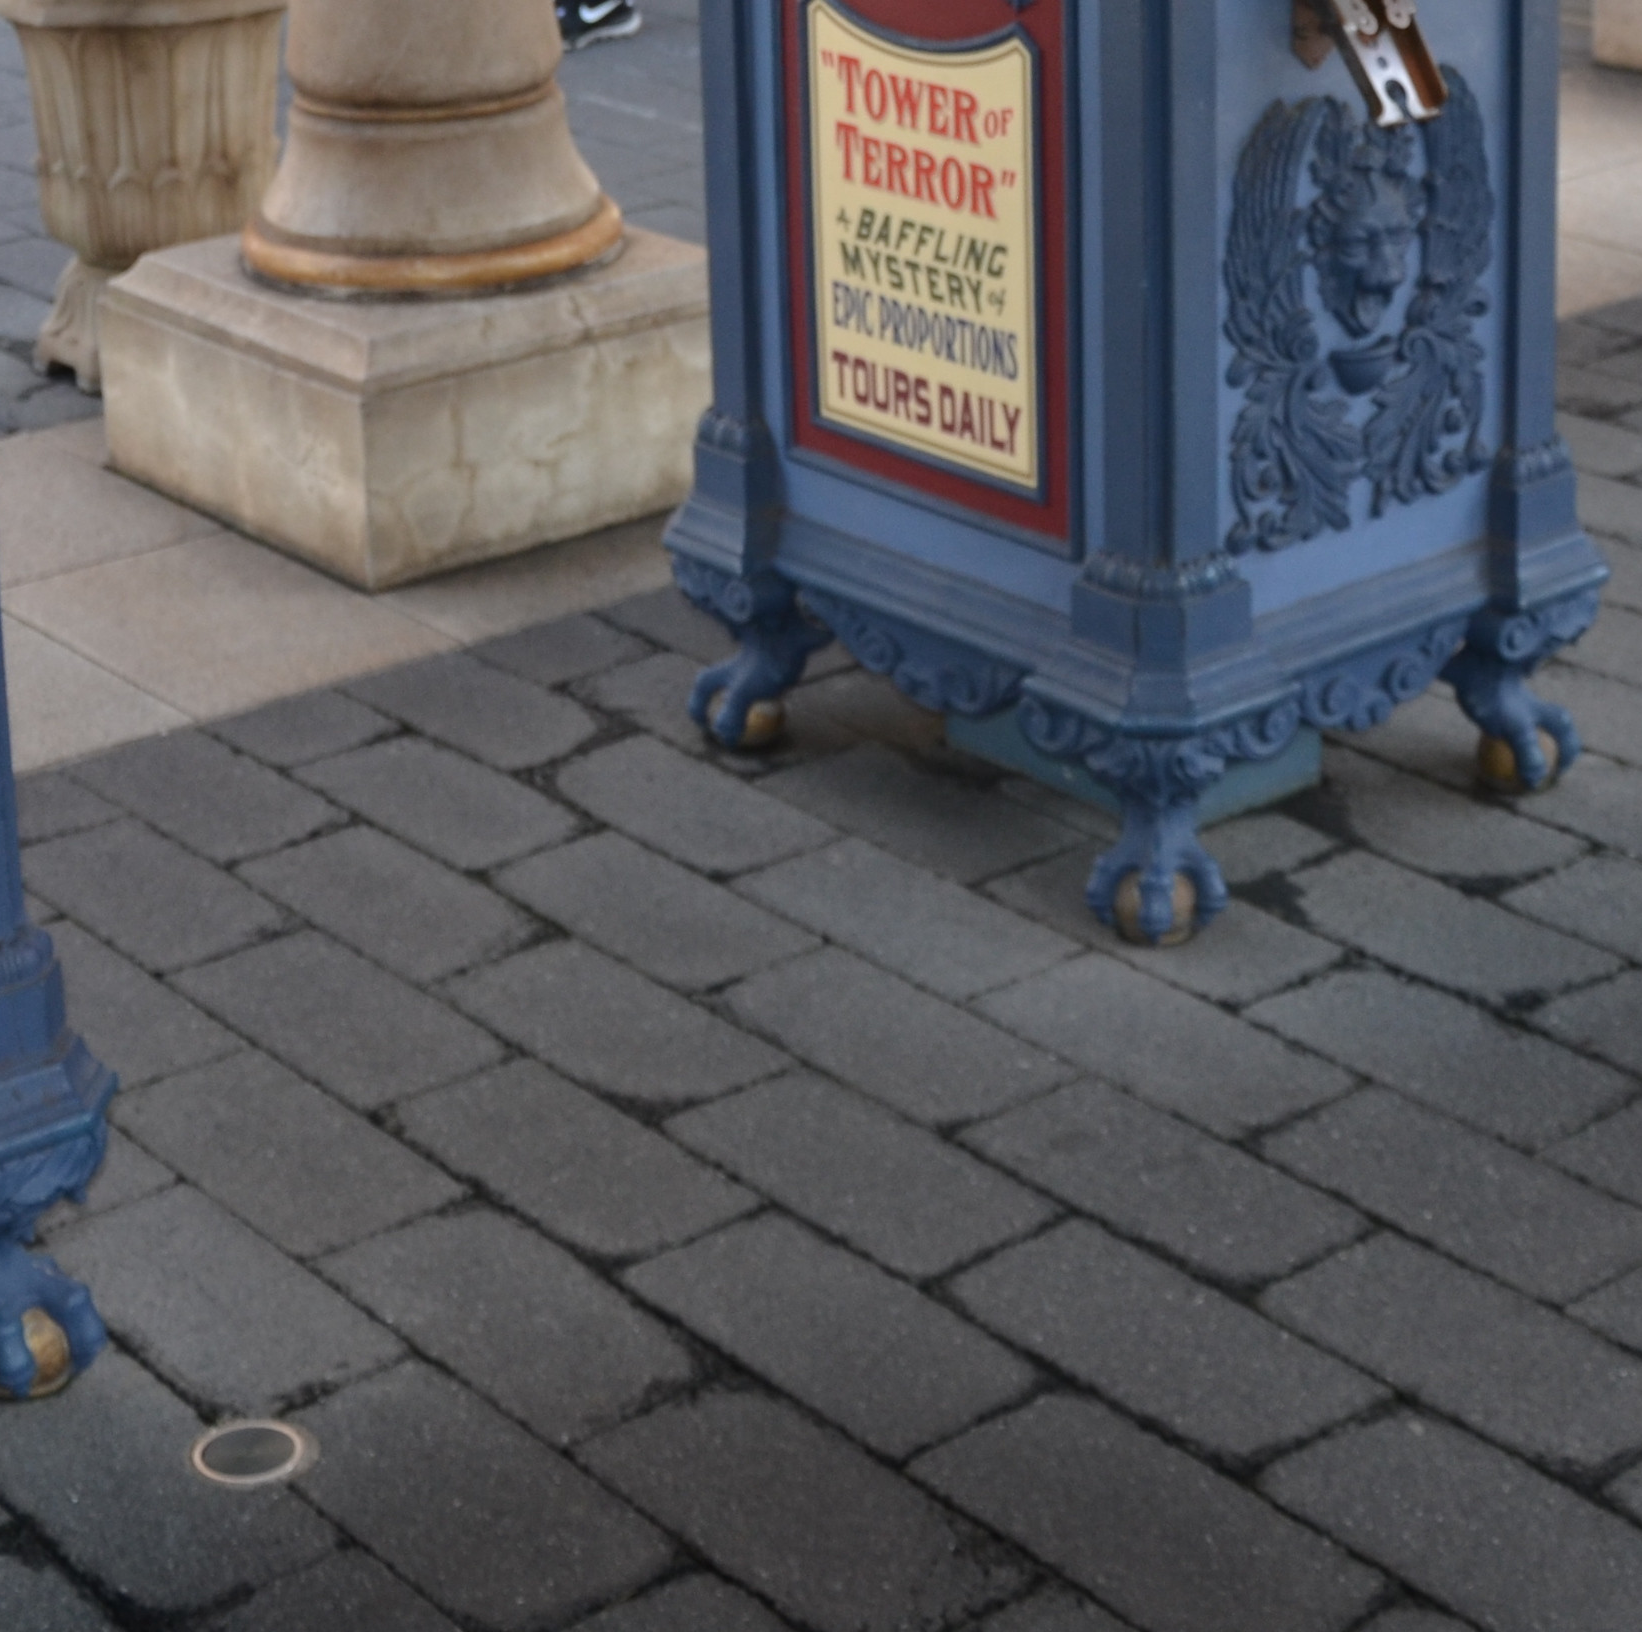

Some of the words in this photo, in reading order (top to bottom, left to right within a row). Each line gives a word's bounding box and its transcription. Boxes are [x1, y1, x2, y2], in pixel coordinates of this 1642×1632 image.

[821, 50, 981, 146] "TOWER
[983, 106, 1013, 139] OF
[835, 120, 1017, 220] TERROR"
[840, 241, 983, 314] MYSTERY
[856, 208, 1008, 279] BAFFLING
[832, 280, 874, 338] EPIC
[879, 295, 1018, 381] PROPORTIONS
[832, 350, 933, 426] TOURS
[939, 382, 1021, 456] DAILY
